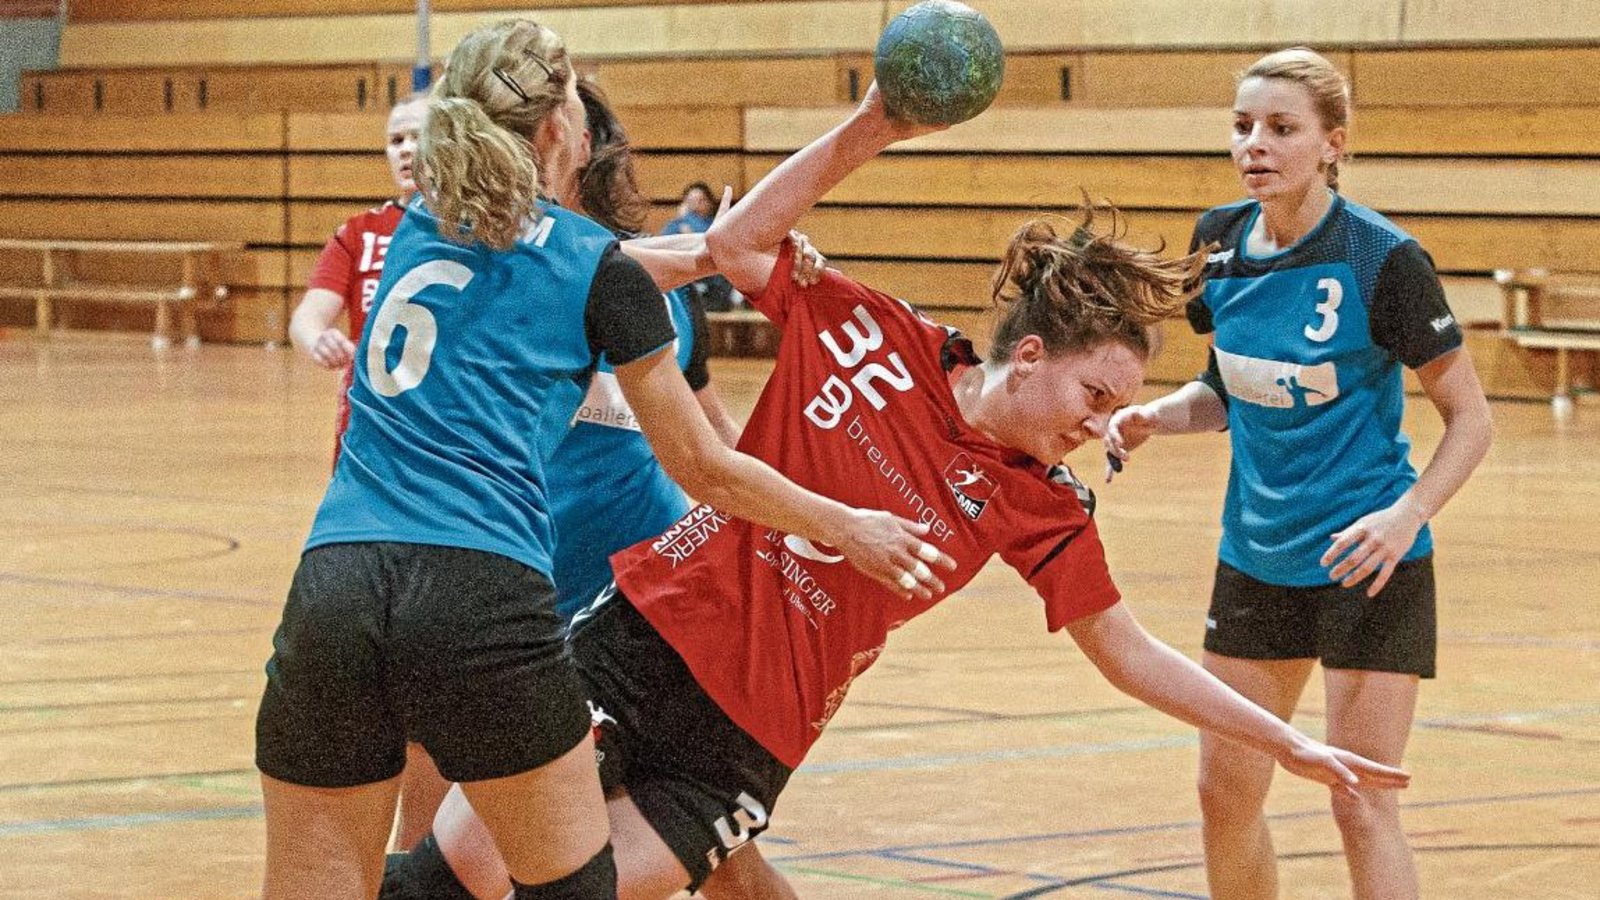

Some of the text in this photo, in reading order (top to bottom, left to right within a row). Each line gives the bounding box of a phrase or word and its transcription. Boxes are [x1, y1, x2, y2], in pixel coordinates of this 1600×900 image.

[367, 259, 475, 397] 6
[1304, 278, 1343, 342] 3
[818, 304, 914, 411] 32
[847, 415, 955, 542] breuninger
[652, 504, 713, 552] MANN
[662, 510, 733, 569] WERK
